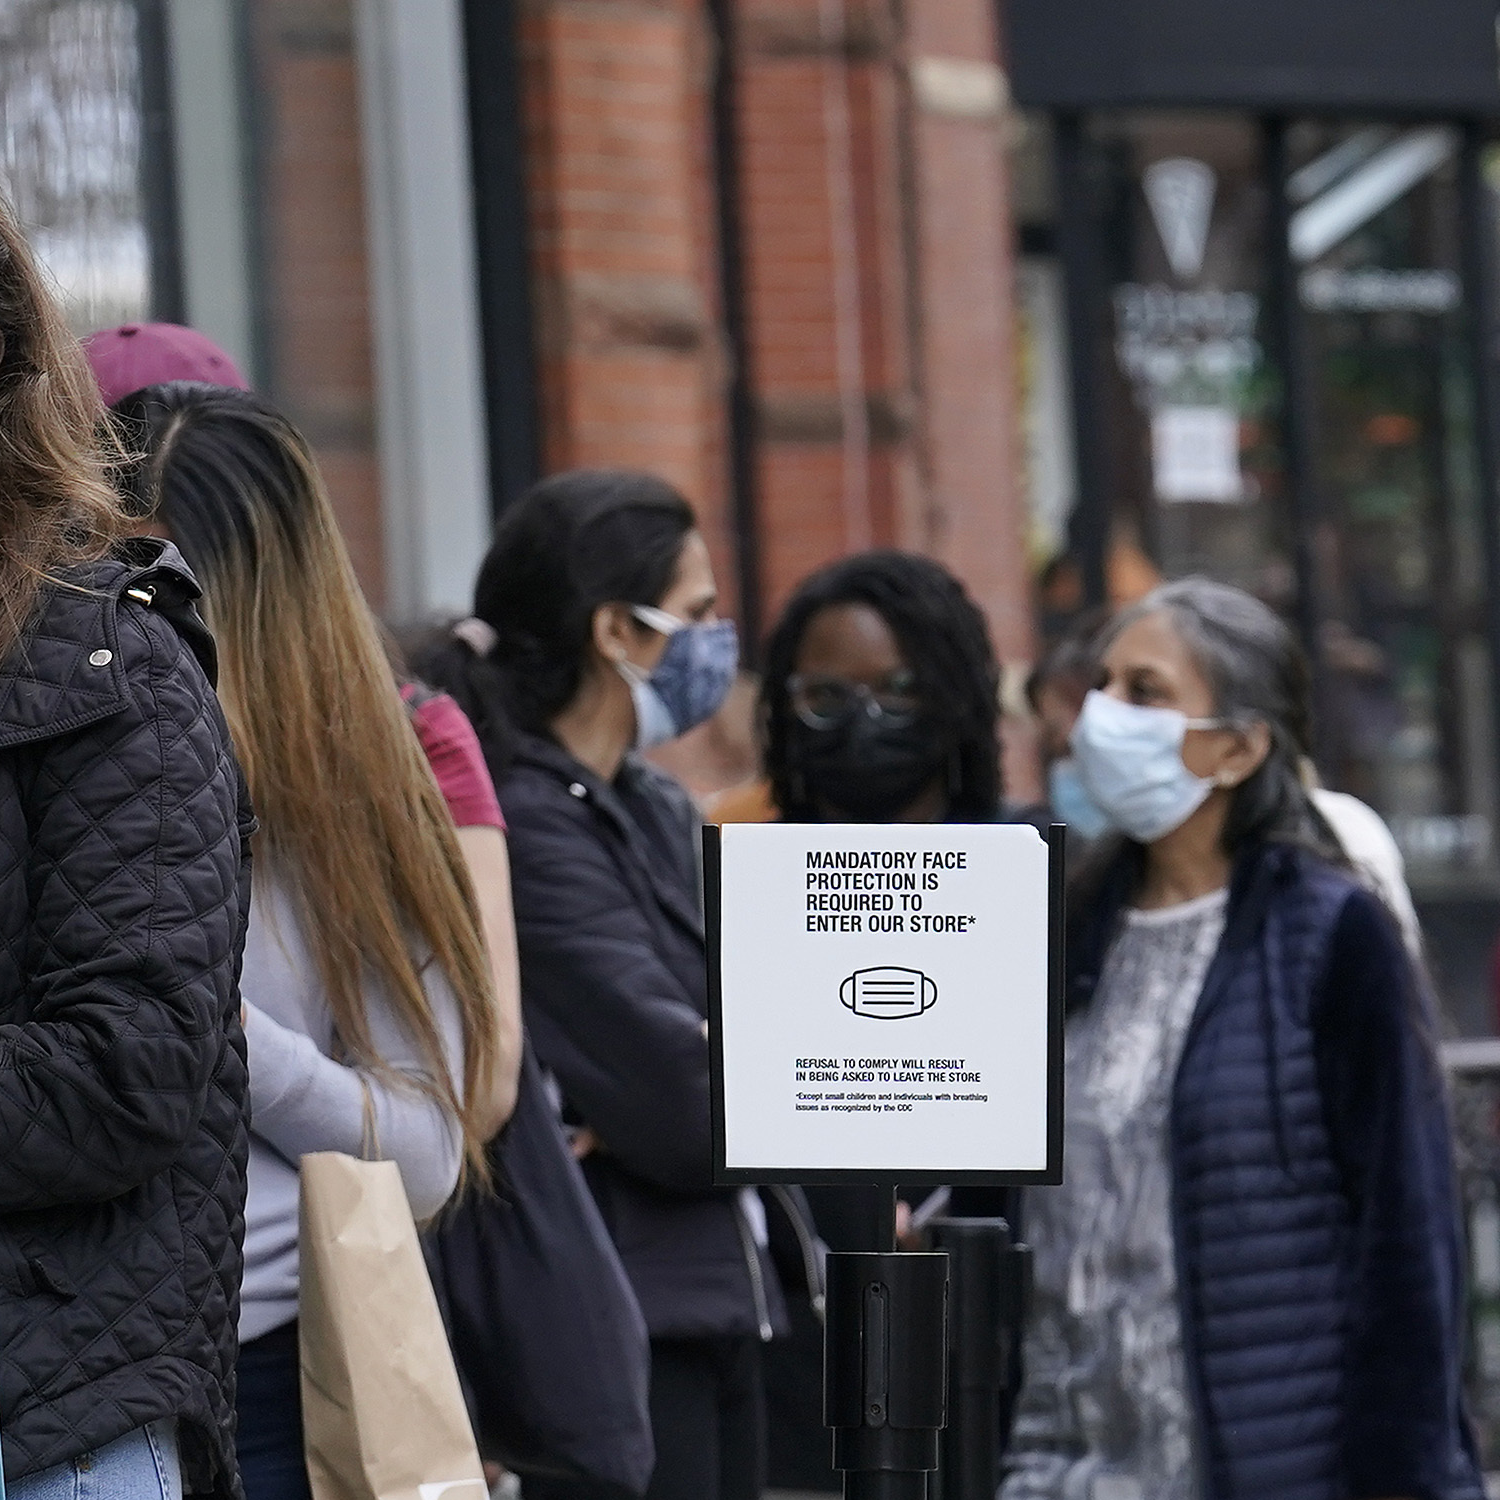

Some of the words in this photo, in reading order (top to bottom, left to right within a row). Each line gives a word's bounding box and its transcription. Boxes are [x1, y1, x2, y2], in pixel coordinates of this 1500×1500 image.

[806, 851, 917, 869] MANDATORY
[923, 851, 967, 869] FACE
[806, 873, 916, 890] PROTECTION
[922, 873, 939, 890] IS
[806, 894, 894, 912] REQUIRED
[900, 894, 923, 911] TO
[806, 915, 862, 932] ENTER
[868, 915, 904, 932] OUR
[795, 1058, 840, 1069] REFUSAL
[843, 1058, 856, 1069] TO
[858, 1058, 899, 1069] COMPLY
[901, 1058, 925, 1069] WILL
[928, 1058, 966, 1069] RESULT
[795, 1072, 806, 1082] IN
[809, 1072, 839, 1082] BEING
[841, 1072, 875, 1082] ASKED
[878, 1072, 890, 1082] TO
[893, 1072, 924, 1082] LEAVE
[927, 1072, 946, 1082] THE
[948, 1072, 981, 1082] STORE
[825, 1092, 845, 1100] small
[846, 1092, 877, 1100] children
[878, 1092, 892, 1100] and
[935, 1092, 950, 1100] with
[953, 1092, 988, 1102] breathing
[831, 1104, 871, 1113] recognized
[873, 1104, 882, 1113] by
